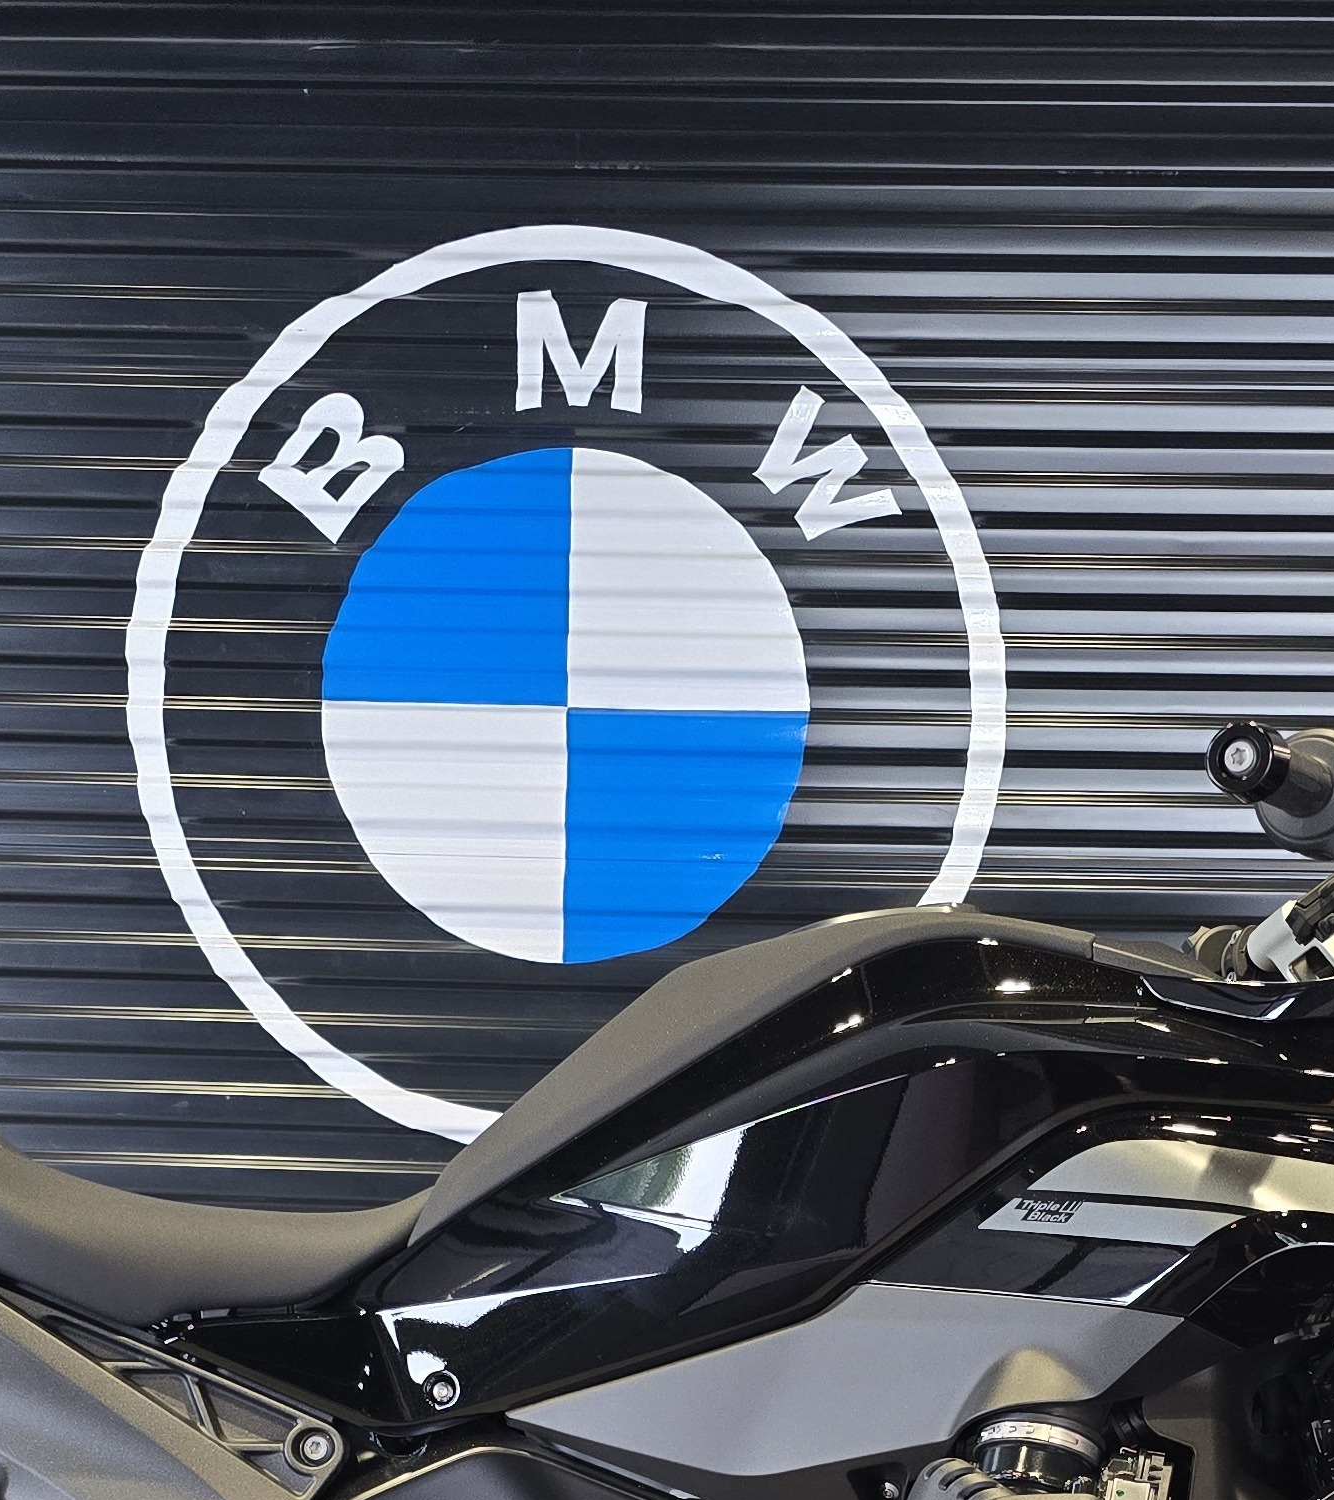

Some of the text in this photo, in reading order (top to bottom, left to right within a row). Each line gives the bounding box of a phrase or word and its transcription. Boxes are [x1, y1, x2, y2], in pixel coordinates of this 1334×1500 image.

[258, 290, 902, 544] BMW
[1020, 1200, 1061, 1212] Triple
[1026, 1212, 1069, 1223] Black
